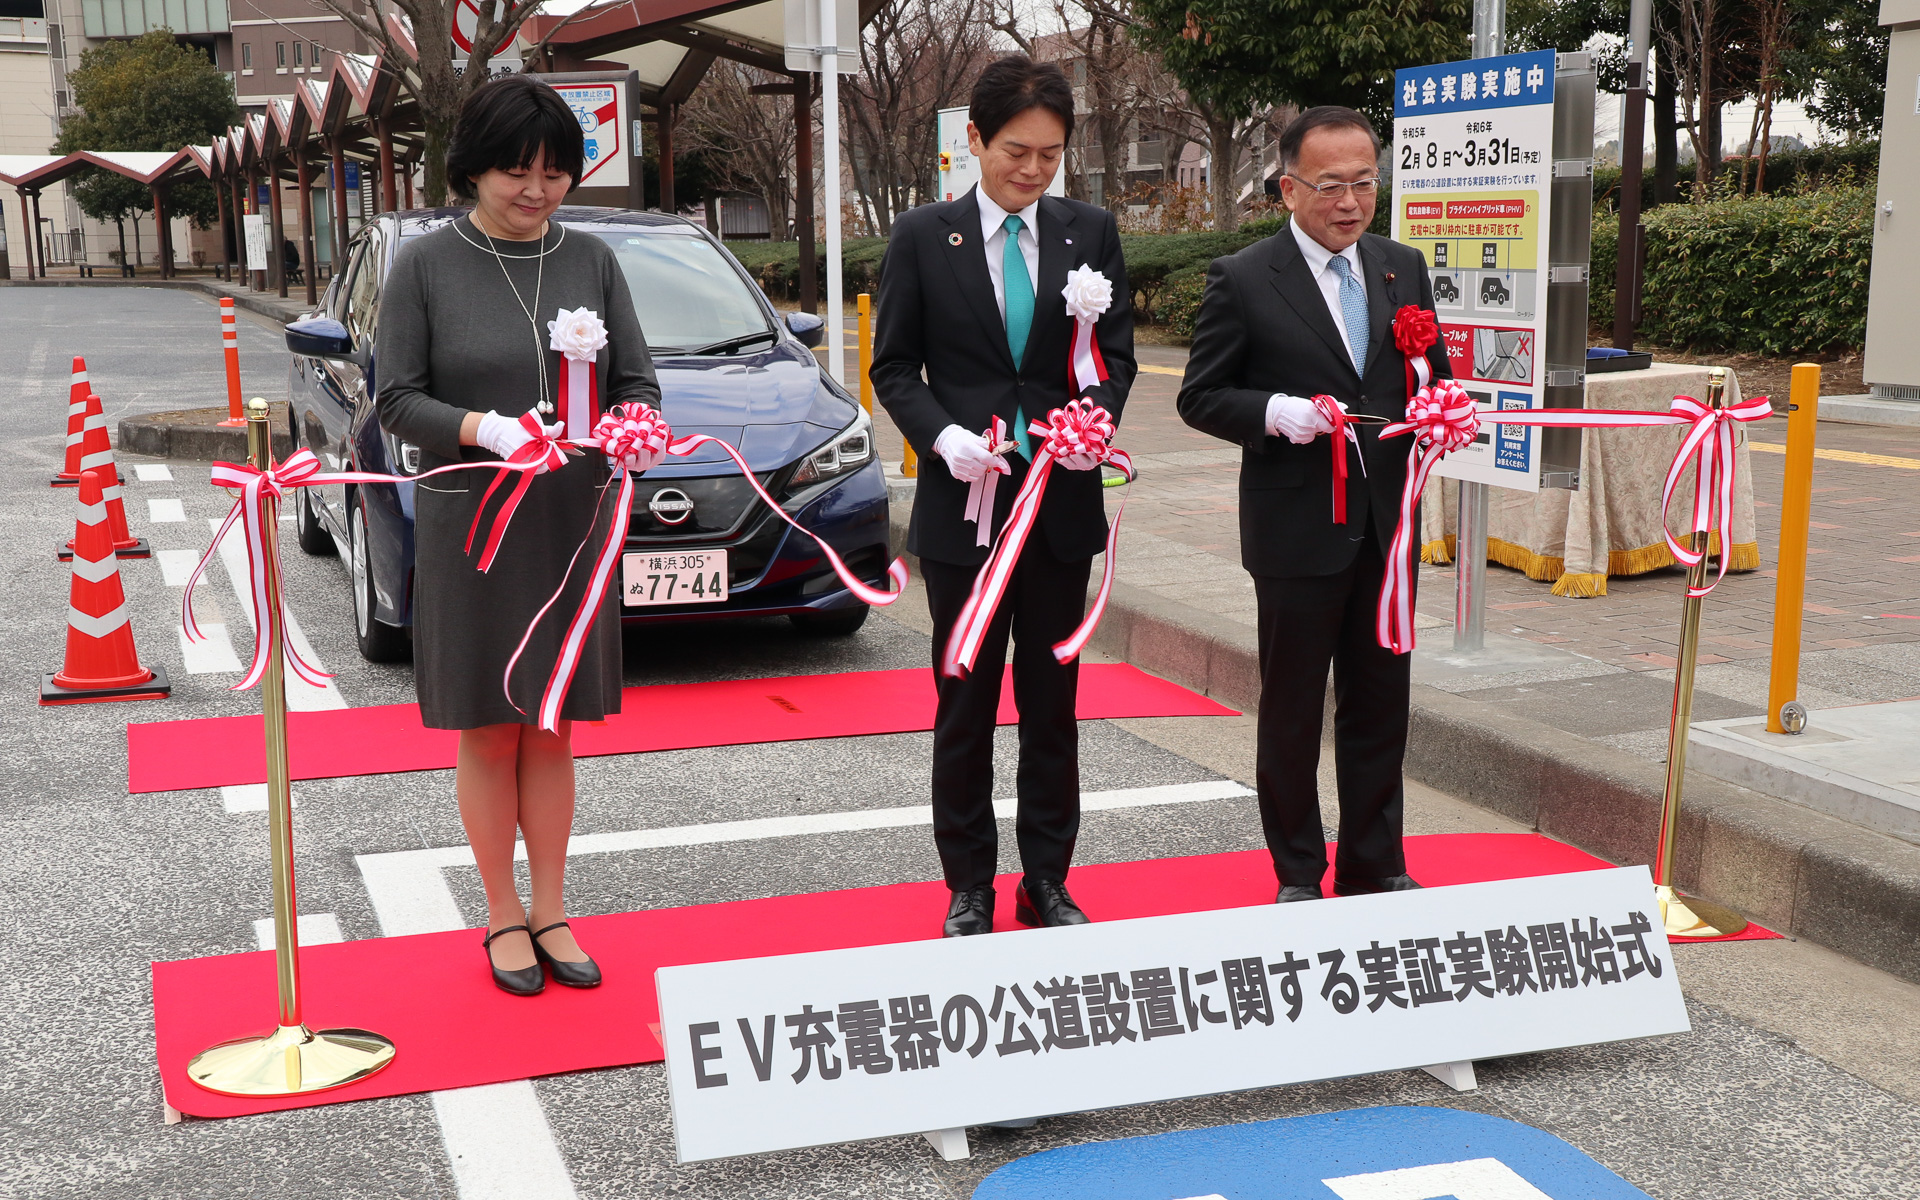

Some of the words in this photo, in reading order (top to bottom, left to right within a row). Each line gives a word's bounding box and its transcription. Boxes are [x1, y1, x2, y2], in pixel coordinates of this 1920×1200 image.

[1403, 64, 1544, 107] 社会実験実施中
[557, 90, 611, 98] 等放置禁止区域
[1402, 127, 1426, 139] 令和5年
[1466, 121, 1493, 134] 令和6年
[1402, 174, 1538, 189] EV充電器の公道設置に関する実証実験を行っています。
[1410, 223, 1523, 236] 充電中に限り枠内に駐車が可能です。
[1441, 330, 1468, 342] ーブルが
[1500, 450, 1525, 460] アンケートに
[650, 502, 694, 511] NISSAN
[630, 582, 644, 595] ぬ
[647, 572, 722, 600] 77-44
[688, 911, 1663, 1090] EV充電器の公道設置に関する実証実験開始式
